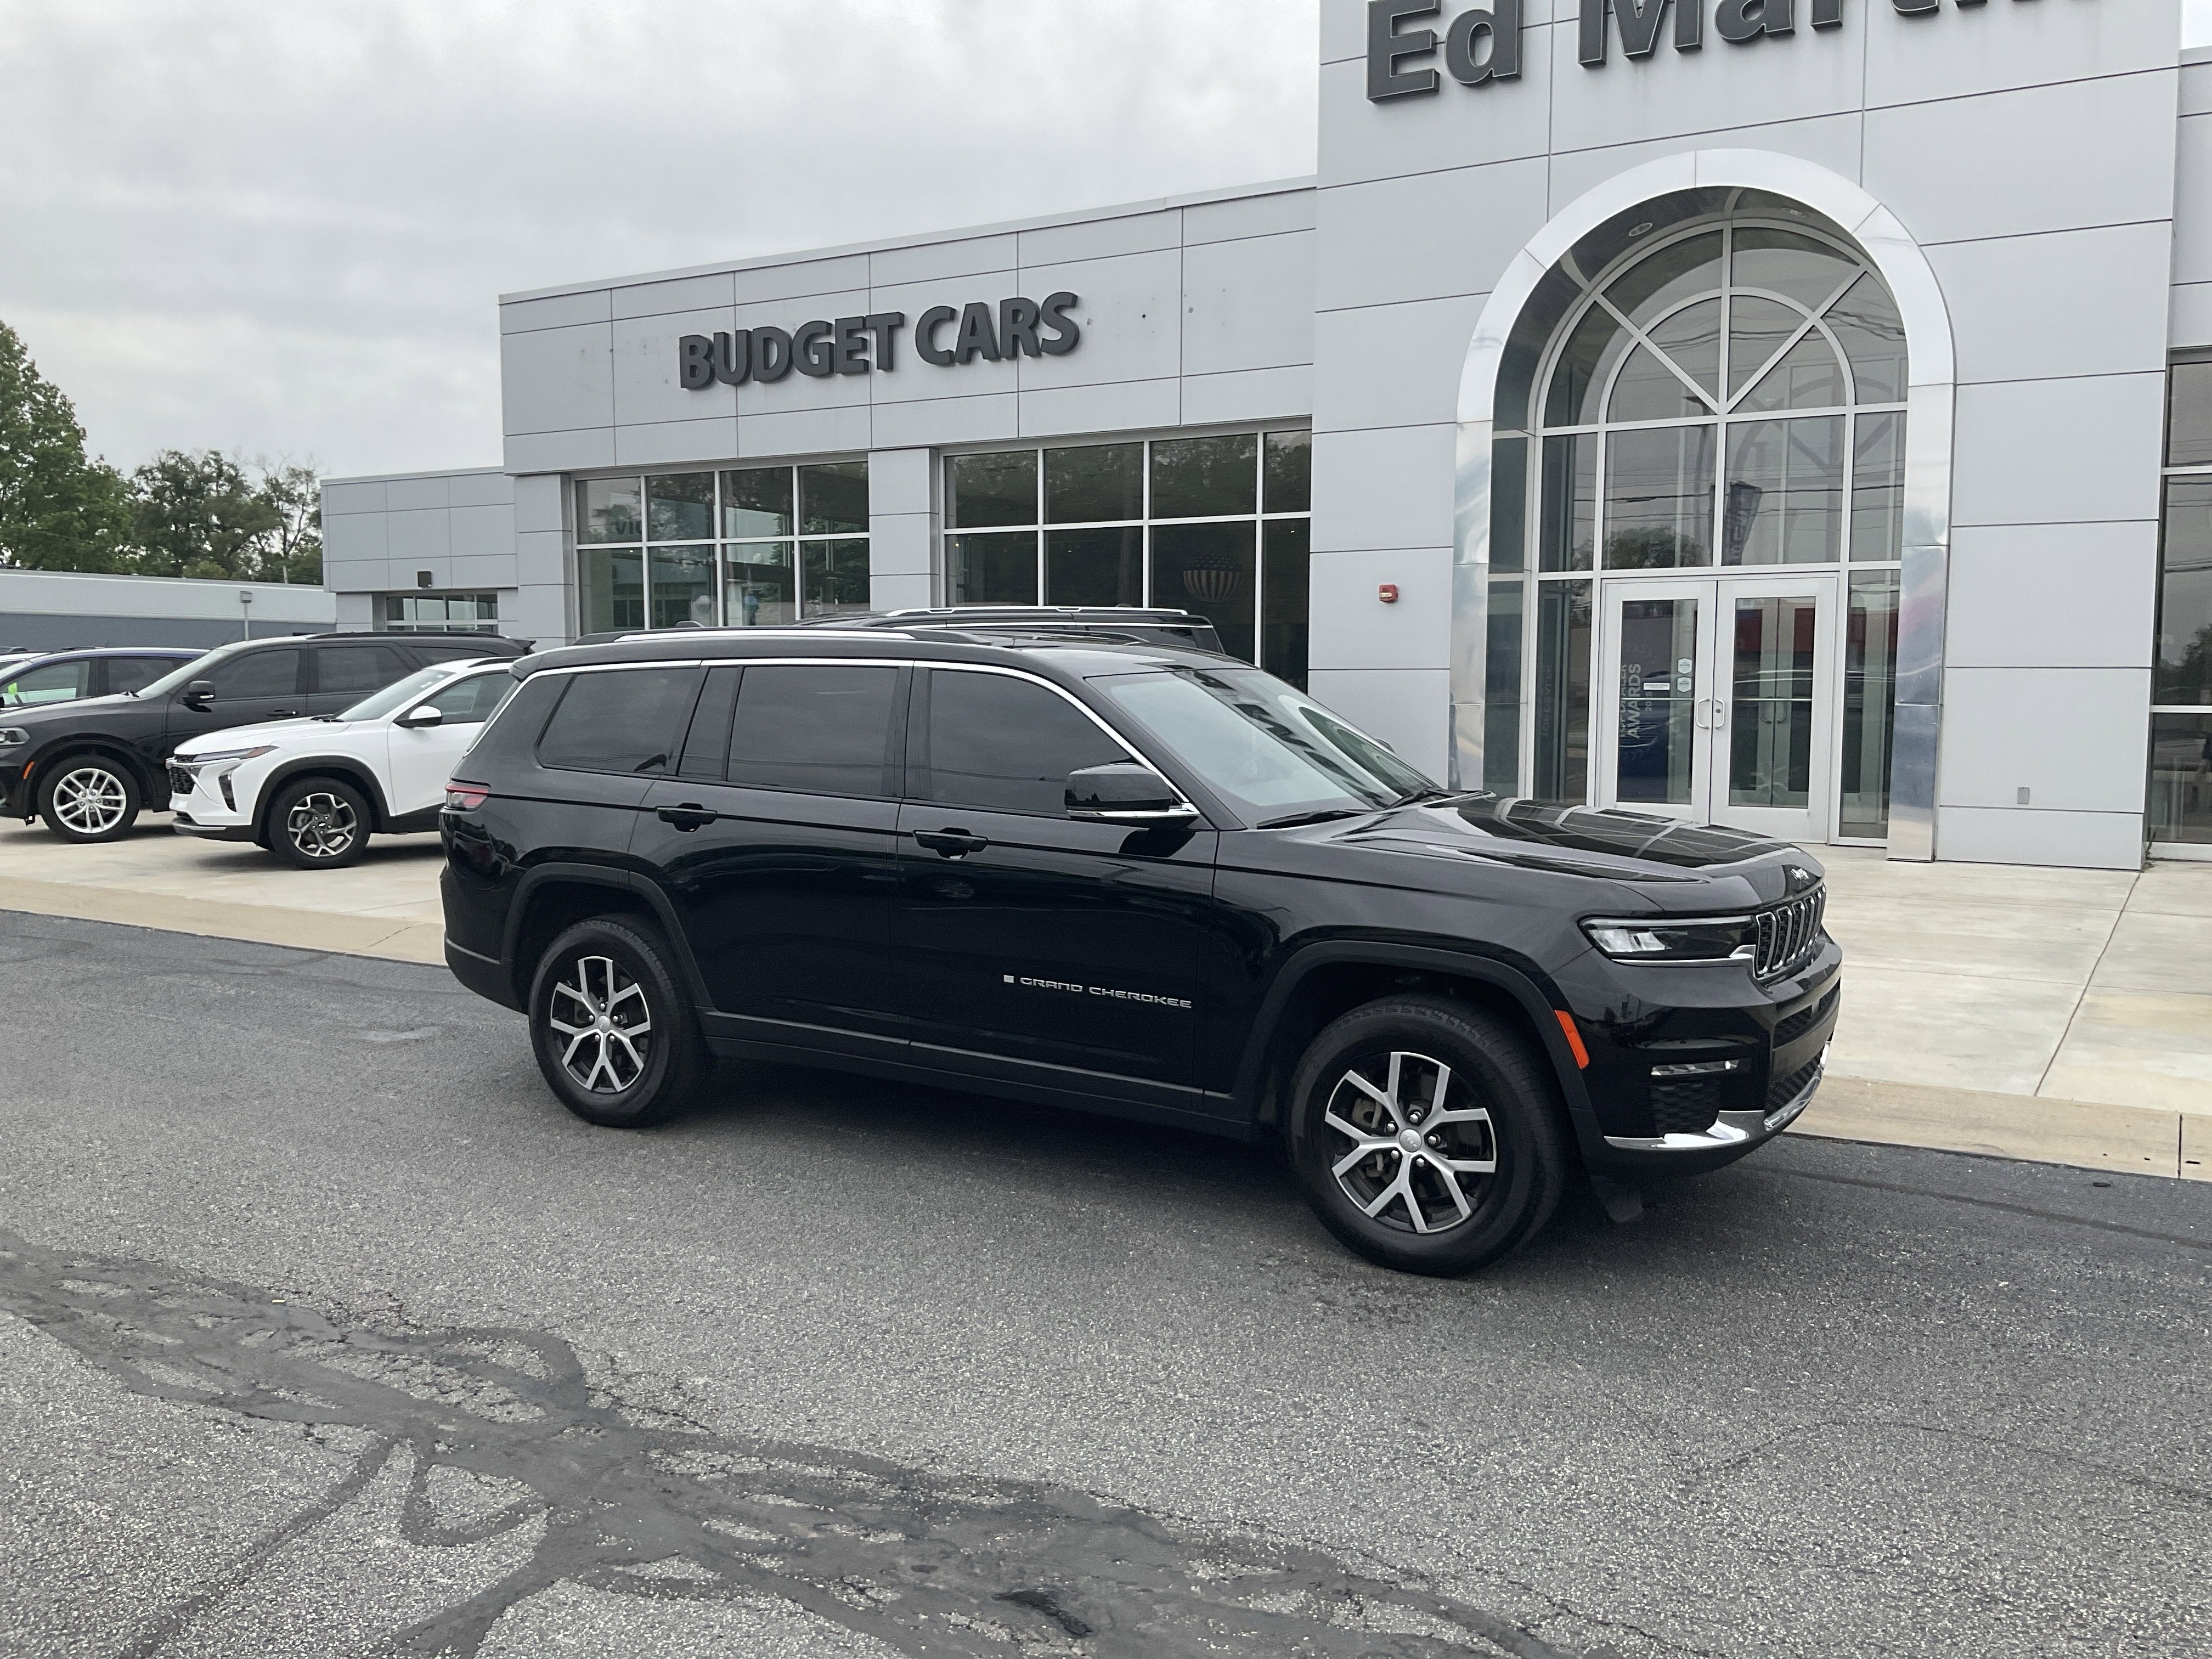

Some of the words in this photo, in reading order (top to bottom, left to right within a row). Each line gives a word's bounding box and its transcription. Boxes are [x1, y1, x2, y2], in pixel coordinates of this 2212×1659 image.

[1367, 0, 1523, 103] Ed
[679, 312, 905, 390] BUDGET
[915, 291, 1079, 365] CARS
[1627, 663, 1642, 739] AWARDS
[1020, 977, 1083, 992] GRAND
[1088, 987, 1192, 1008] CHEROKEE
